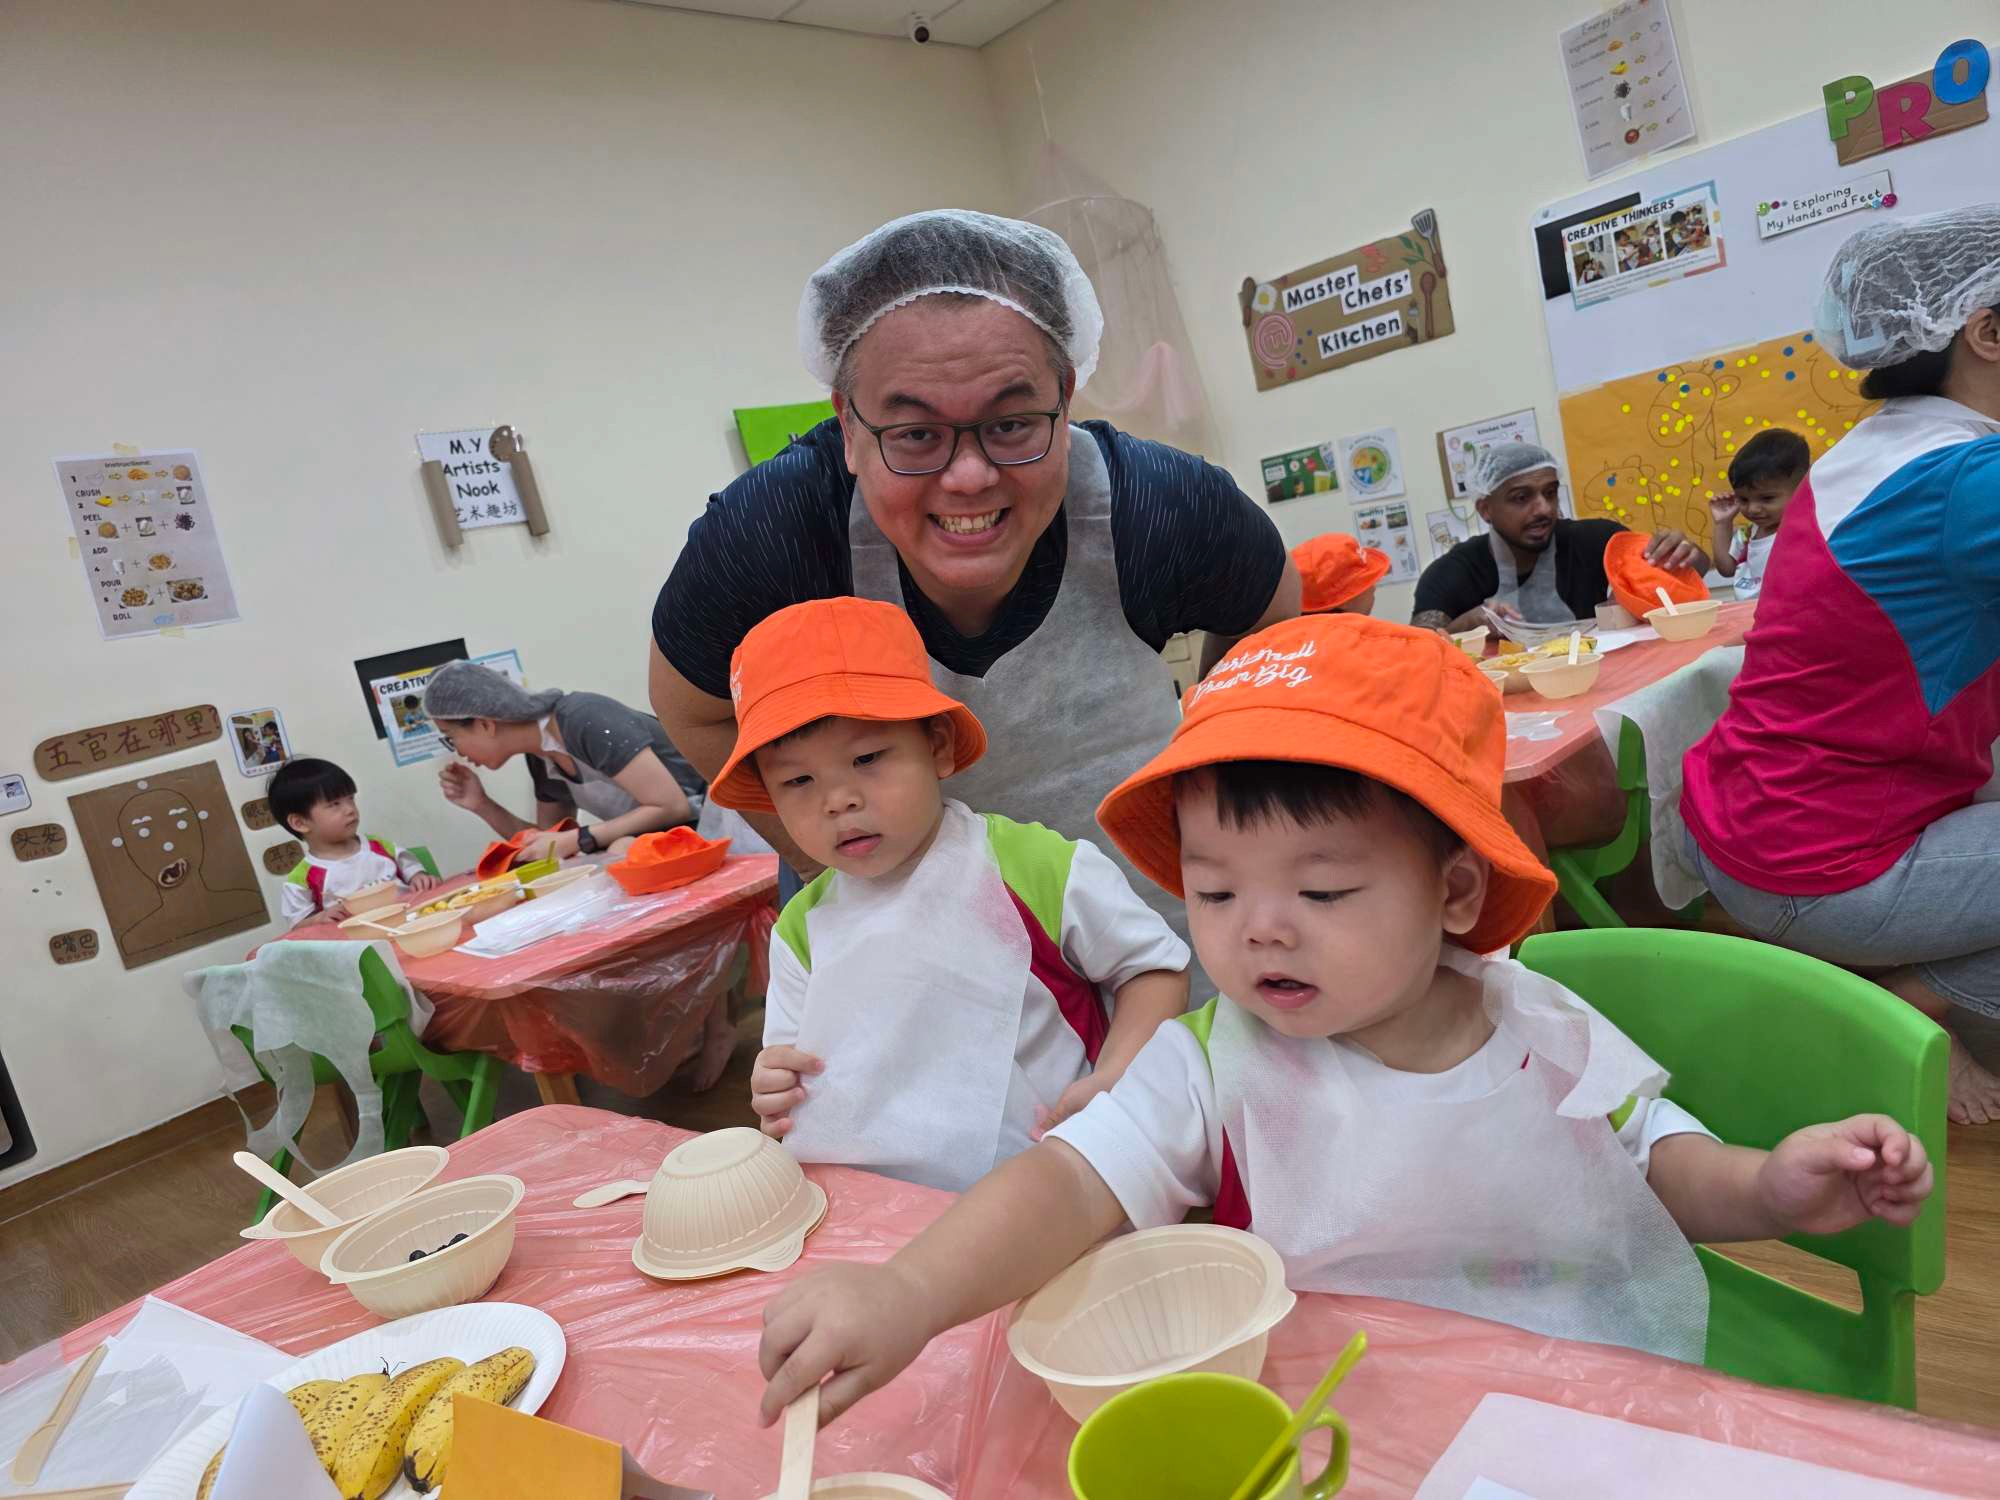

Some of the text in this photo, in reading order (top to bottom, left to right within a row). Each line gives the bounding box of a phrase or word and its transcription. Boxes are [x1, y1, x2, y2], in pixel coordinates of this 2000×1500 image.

[1823, 39, 1990, 148] PRO
[1793, 186, 1852, 211] Exploring
[1767, 188, 1883, 231] My Hands and Feet
[1567, 199, 1675, 243] CREATIVE THINKERS
[1286, 271, 1356, 309] Master
[1320, 317, 1401, 354] Kitchen
[443, 461, 501, 477] Artists
[75, 489, 101, 498] CRUSH
[456, 480, 501, 498] Nook
[83, 513, 102, 521] PEEL
[92, 546, 108, 555] ADD
[101, 579, 122, 588] POUR
[113, 612, 132, 621] ROLL
[1254, 664, 1312, 688] Big
